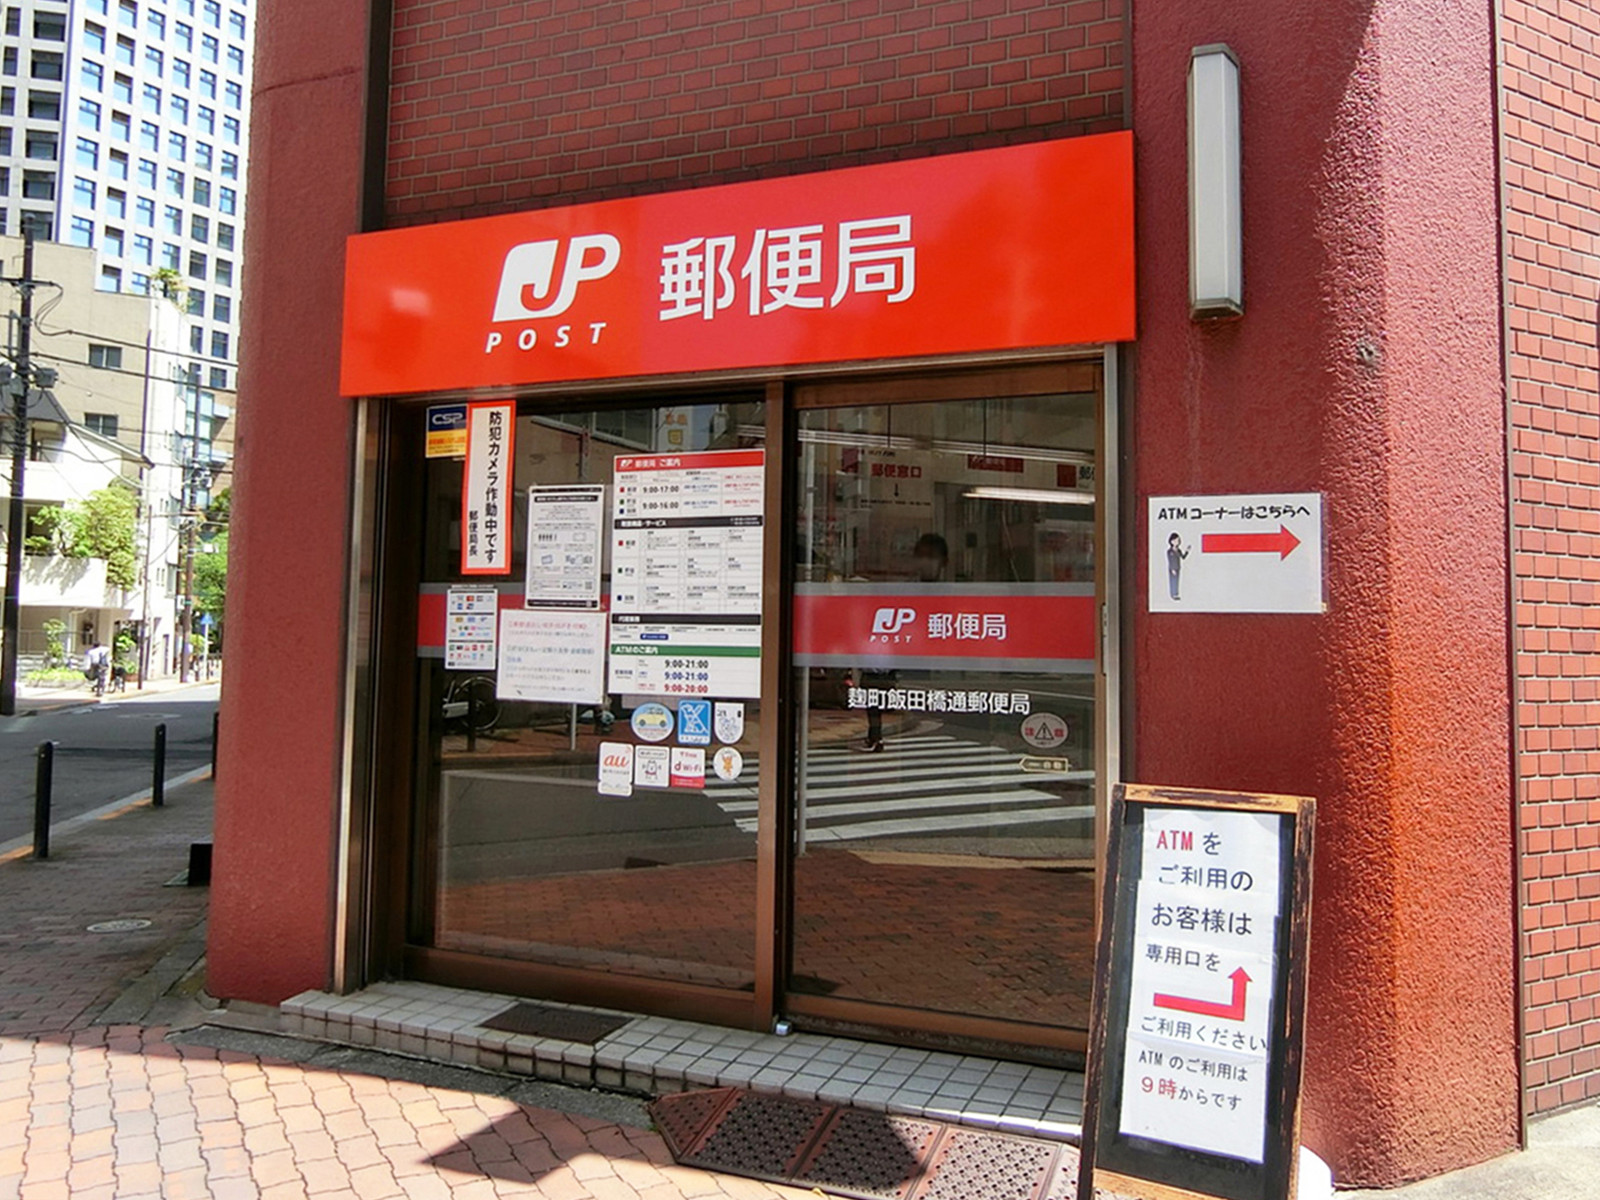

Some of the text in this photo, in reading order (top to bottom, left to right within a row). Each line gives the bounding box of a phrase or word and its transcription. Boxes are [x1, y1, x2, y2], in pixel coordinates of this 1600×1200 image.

[492, 214, 917, 323] JP 郵便局
[485, 322, 606, 353] POST
[432, 413, 464, 425] CSP
[484, 411, 503, 564] 防犯カメラ作動中です
[643, 485, 680, 494] 9:00-17:00
[643, 501, 679, 510] 9:00-16:00
[1157, 505, 1311, 520] ATM コーナーはこちらへ
[927, 612, 1007, 640] 郵便局
[869, 635, 912, 643] POST
[664, 659, 709, 669] 9:00-21:00
[664, 671, 709, 681] 9:00-21:00
[664, 684, 709, 693] 9:00-20:00
[603, 753, 630, 768] au
[1156, 830, 1194, 851] ATM
[1158, 864, 1254, 892] ご利用の
[1151, 902, 1253, 935] お客様は
[1145, 943, 1221, 973] 専用口を
[1140, 1015, 1267, 1051] ご利用ください
[1140, 1076, 1243, 1112] 9時からです
